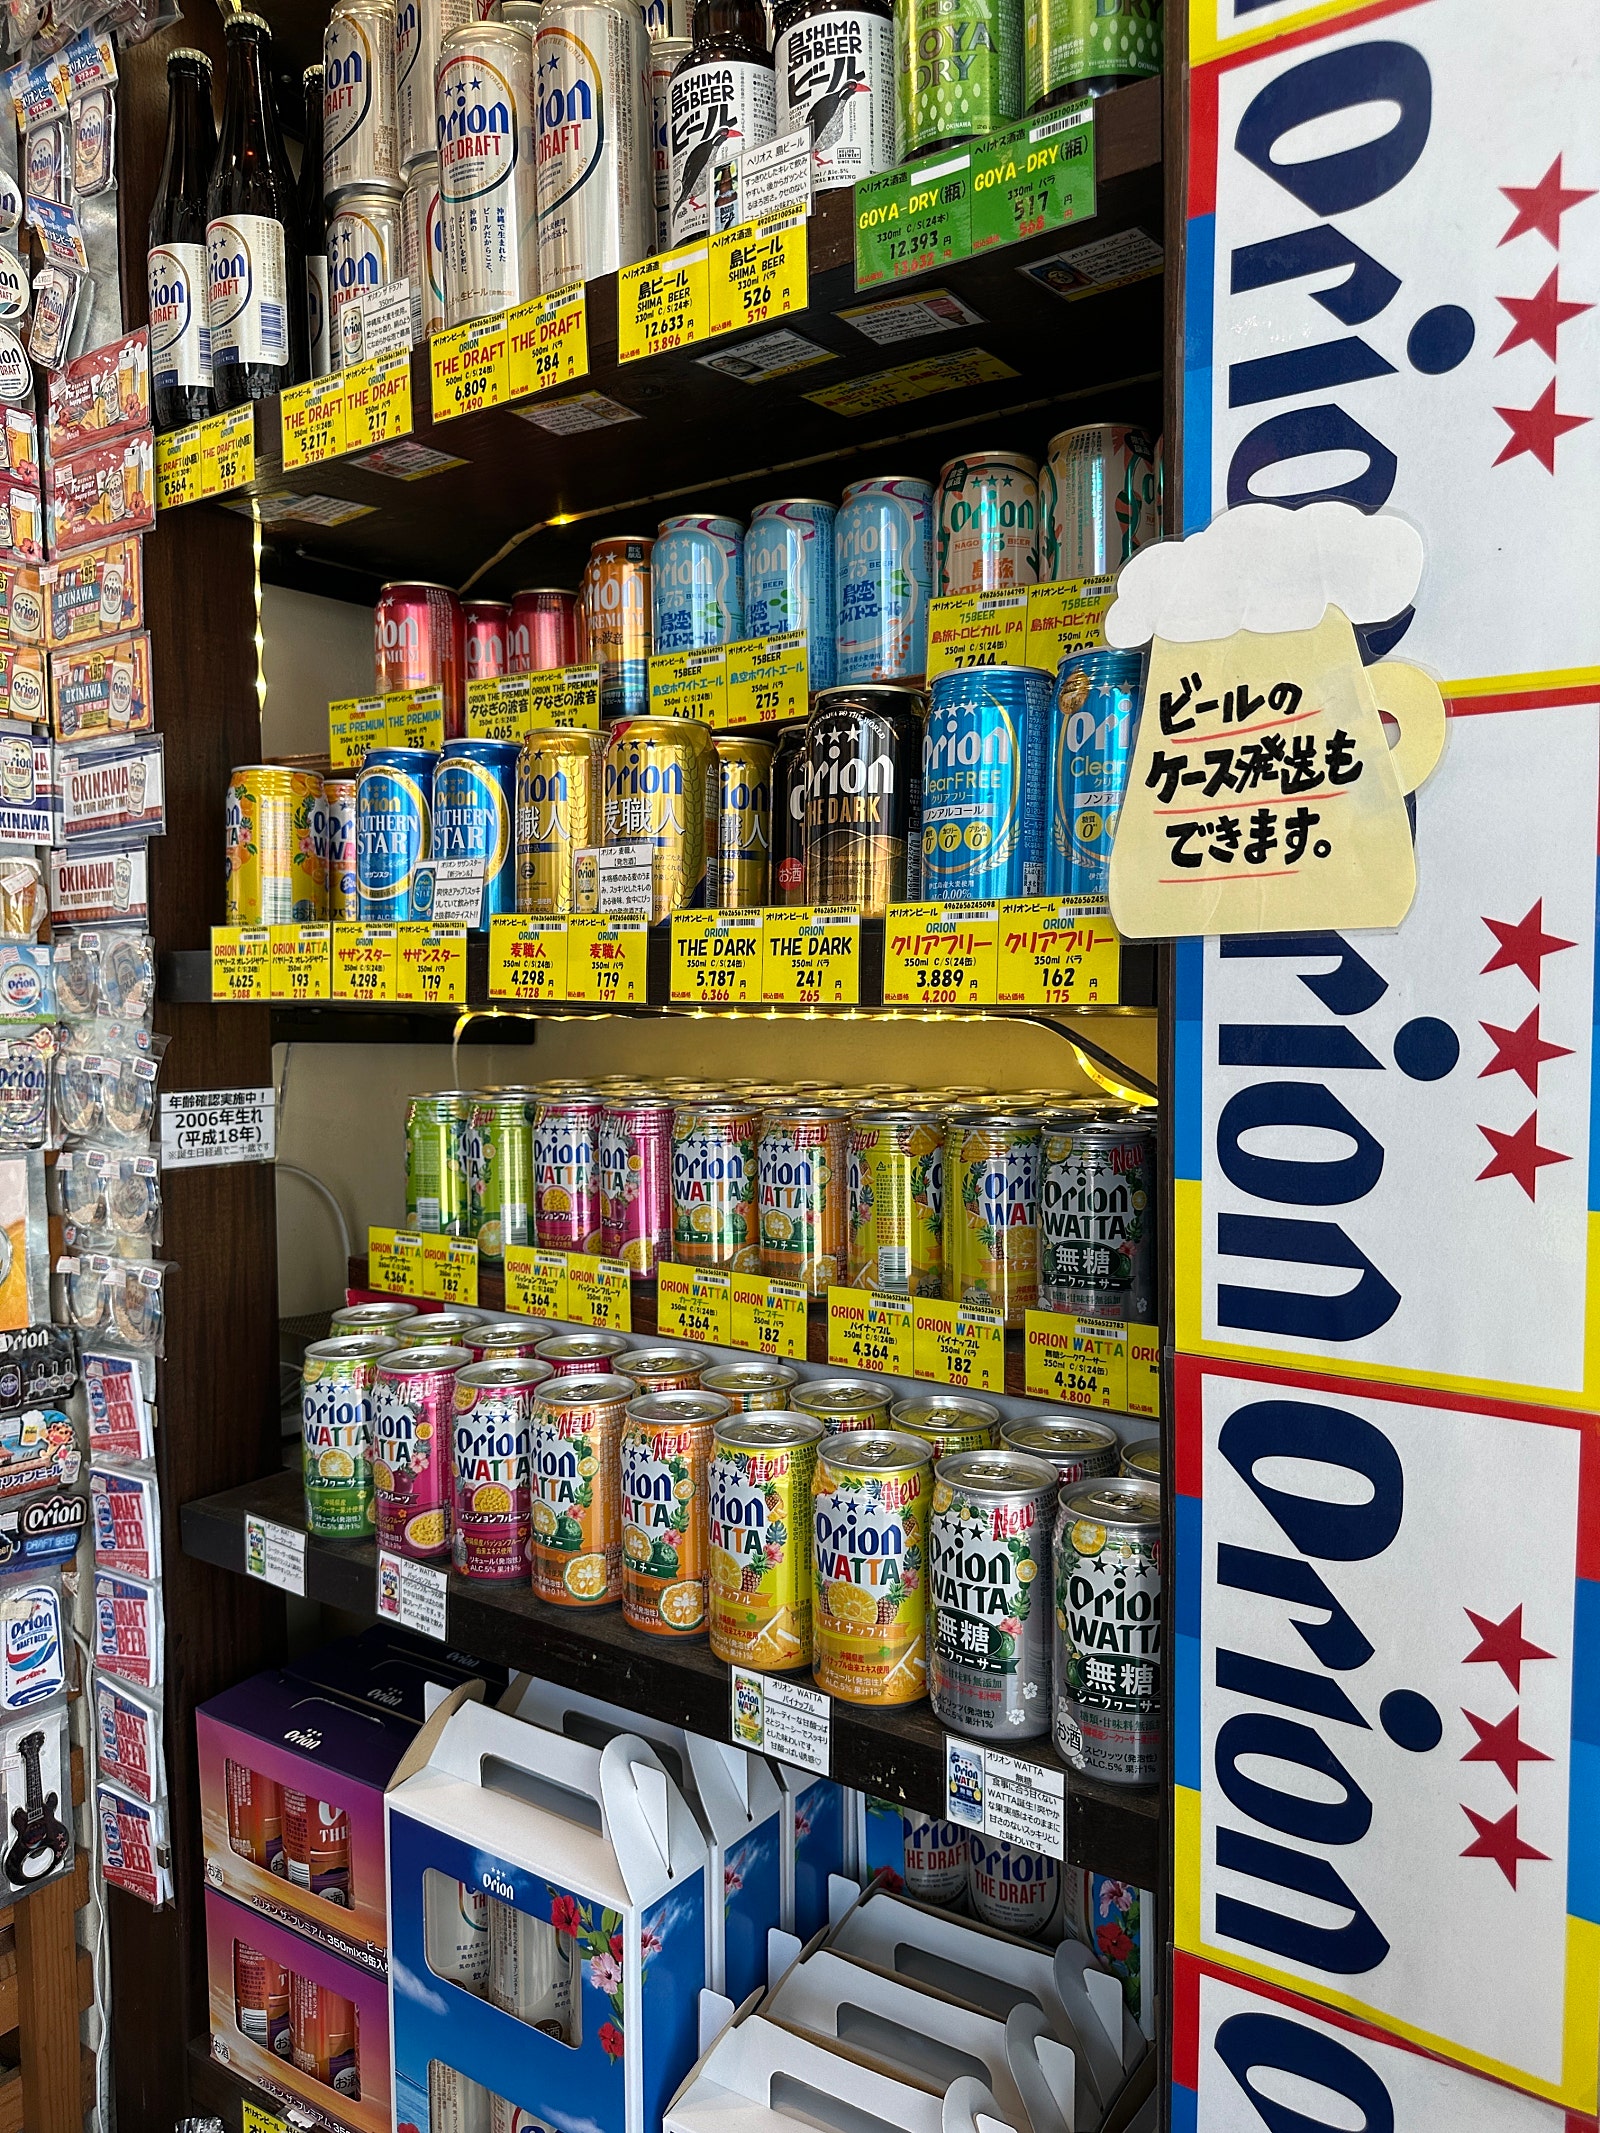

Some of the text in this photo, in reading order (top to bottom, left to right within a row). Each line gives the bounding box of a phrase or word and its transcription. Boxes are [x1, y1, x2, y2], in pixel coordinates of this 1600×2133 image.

[806, 21, 860, 42] SHIMA
[813, 36, 863, 59] BEER
[901, 22, 998, 73] GOYA
[684, 70, 732, 91] SHIMA
[788, 56, 866, 109] ビール
[915, 54, 977, 94] DRY
[690, 85, 734, 107] BEER
[672, 104, 738, 156] ビール
[946, 121, 972, 130] OKINAWA
[458, 136, 501, 163] DRAFT
[747, 137, 804, 166] ヘリオス 島ビール
[1014, 191, 1049, 221] 517
[496, 207, 506, 263] 沖縄で生まれた
[711, 228, 752, 249] ヘリオス酒造
[730, 236, 783, 270] 島ビール
[729, 254, 785, 282] SHIMA BEER
[213, 279, 239, 298] DRAFT
[638, 270, 688, 301] 島ビール
[637, 287, 690, 313] SHIMA BEER
[743, 285, 771, 309] 526
[154, 305, 178, 323] DRAFT
[509, 302, 543, 321] オリオンビール
[536, 310, 557, 326] ORION
[747, 306, 767, 323] 579
[511, 311, 582, 353] THE DRAFT
[434, 341, 505, 377] THE DRAFT
[536, 353, 559, 375] 284
[540, 373, 557, 388] 312
[347, 375, 408, 410] THE DRAFT
[284, 398, 343, 431] THE DRAFT
[368, 413, 387, 431] 217
[371, 430, 385, 443] 239
[220, 462, 236, 478] 285
[950, 490, 1034, 532] Orion
[954, 538, 1031, 550] NAGO BEER
[57, 587, 94, 608] OKINAWA
[932, 598, 975, 612] オリオンビール
[959, 610, 996, 625] 75BEER
[931, 620, 1023, 644] 島旅トロピカル IPA
[751, 652, 781, 666] 75BEER
[730, 662, 804, 685] 島空ホワイトエール
[652, 675, 724, 697] 島空ホワイトエール
[470, 700, 528, 719] 夕なぎの波音
[532, 691, 597, 711] 夕なぎの波音
[756, 692, 779, 709] 275
[1158, 671, 1304, 736] ビールの
[388, 710, 442, 728] THE PREMIUM
[759, 709, 777, 721] 303
[332, 718, 385, 735] THE PREMIUM
[605, 753, 682, 797] Orion
[1144, 728, 1365, 804] ケース発送も
[72, 766, 129, 803] OKINAWA
[931, 792, 975, 805] クリアフリー
[604, 798, 685, 836] 麦職人
[827, 796, 880, 825] DARK
[926, 805, 984, 821] ノンアルコール
[357, 833, 409, 855] STAR
[433, 826, 485, 851] STAR
[1164, 806, 1333, 869] できます。
[59, 862, 115, 892] OKINAWA
[814, 906, 857, 914] 4962656129916
[889, 907, 938, 918] オリオンビール
[944, 901, 996, 910] 4962656245098
[799, 926, 824, 936] ORION
[926, 923, 956, 933] ORION
[214, 944, 269, 957] ORION WATTA
[510, 943, 546, 958] 麦職人
[590, 943, 625, 959] 麦職人
[678, 938, 756, 957] THE DARK
[770, 937, 852, 956] THE DARK
[890, 934, 993, 956] クリアフリー
[1005, 930, 1114, 954] クリアフリー
[338, 950, 391, 962] サザンスター
[403, 949, 460, 962] サザンスター
[904, 958, 929, 967] 350ml
[291, 974, 309, 987] 193
[422, 975, 441, 990] 179
[597, 972, 619, 987] 179
[796, 971, 822, 988] 241
[1043, 968, 1075, 987] 162
[799, 990, 820, 1002] 265
[1045, 990, 1069, 1003] 175
[175, 1107, 263, 1128] 2006年生れ
[178, 1126, 262, 1149] (平成18年)
[533, 1137, 590, 1168] Orion
[1109, 1143, 1143, 1173] New
[534, 1164, 589, 1186] WATTA
[675, 1150, 742, 1180] Orion
[676, 1181, 742, 1202] WATTA
[1044, 1177, 1128, 1214] Orion
[1044, 1212, 1126, 1240] WATTA
[533, 1264, 566, 1279] WATTA
[1055, 1246, 1110, 1276] 無糖
[660, 1279, 729, 1301] ORION WATTA
[591, 1302, 609, 1317] 182
[867, 1309, 911, 1328] WATTA
[758, 1326, 780, 1343] 182
[850, 1321, 891, 1336] パイナップル
[955, 1321, 1001, 1342] WATTA
[936, 1334, 980, 1350] パイナップル
[1073, 1337, 1124, 1357] WATTA
[304, 1395, 372, 1425] Orion
[305, 1424, 370, 1447] WATTA
[558, 1410, 596, 1441] New
[457, 1424, 530, 1457] Orion
[651, 1432, 692, 1462] New
[457, 1458, 530, 1482] WATTA
[747, 1453, 789, 1486] New
[881, 1472, 920, 1512] New
[28, 1501, 82, 1529] Orion
[110, 1494, 142, 1521] DRAFT
[992, 1501, 1036, 1542] New
[115, 1521, 145, 1551] BEER
[816, 1513, 902, 1556] Orion
[817, 1550, 901, 1586] WATTA
[931, 1572, 1010, 1617] WATTA
[115, 1599, 147, 1628] DRAFT
[824, 1617, 889, 1639] パイナップル
[936, 1609, 990, 1654] 無糖
[1084, 1660, 1154, 1696] 無糖
[1214, 1399, 1443, 1976] Orion
[772, 1681, 823, 1703] オリオン WATTA
[767, 1730, 815, 1753] とした味わいです。
[987, 1752, 1044, 1776] オリオン WATTA
[1086, 1755, 1123, 1772] ALC.5%
[992, 1778, 1057, 1805] 食事に合う甘くない
[988, 1801, 1060, 1832] な果実感はそのままに
[989, 1814, 1059, 1845] 甘さのないスッキリとし
[482, 1871, 515, 1901] Orion
[974, 1869, 996, 1899] THE
[999, 1882, 1047, 1904] DRAFT
[252, 1895, 278, 1914] オリオン
